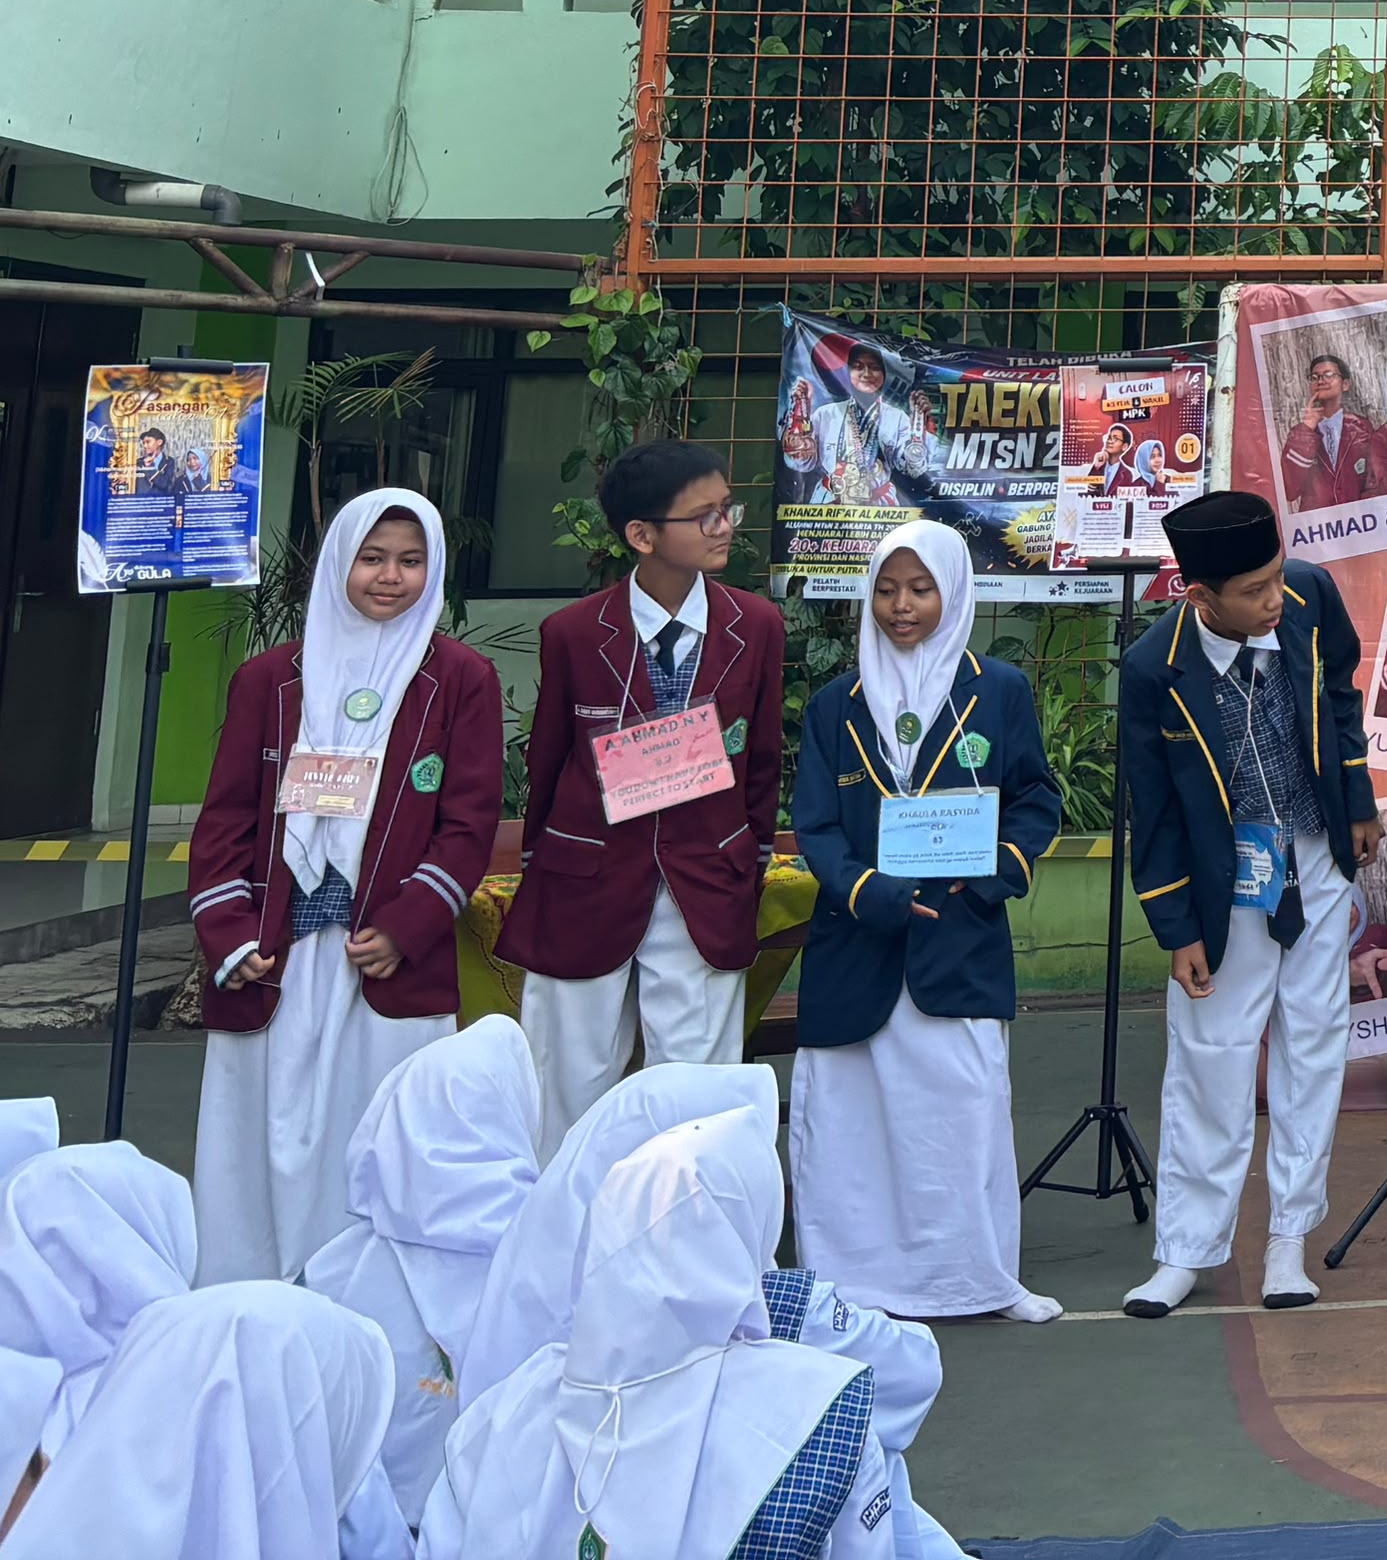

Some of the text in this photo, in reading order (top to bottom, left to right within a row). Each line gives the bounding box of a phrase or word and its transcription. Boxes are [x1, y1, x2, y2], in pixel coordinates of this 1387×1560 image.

[1006, 356, 1062, 367] TELAH
[982, 369, 1060, 381] UNIT LA
[1119, 382, 1154, 395] CALON
[1122, 407, 1146, 420] MPK
[946, 432, 1037, 470] MTsN
[1180, 442, 1196, 455] 01
[938, 481, 996, 497] DISIPLIN
[783, 508, 909, 520] KHANZA RIF'AT AL AMZAT
[1017, 523, 1051, 533] GABUNG
[1290, 513, 1378, 548] AHMAD
[845, 530, 869, 539] LEBIH
[788, 537, 819, 553] 20+
[137, 568, 172, 580] GULA
[806, 566, 835, 574] UNTUK
[812, 577, 841, 585] PELATIH
[812, 585, 857, 593] BERPRESTASI
[621, 719, 679, 746] AHMAD
